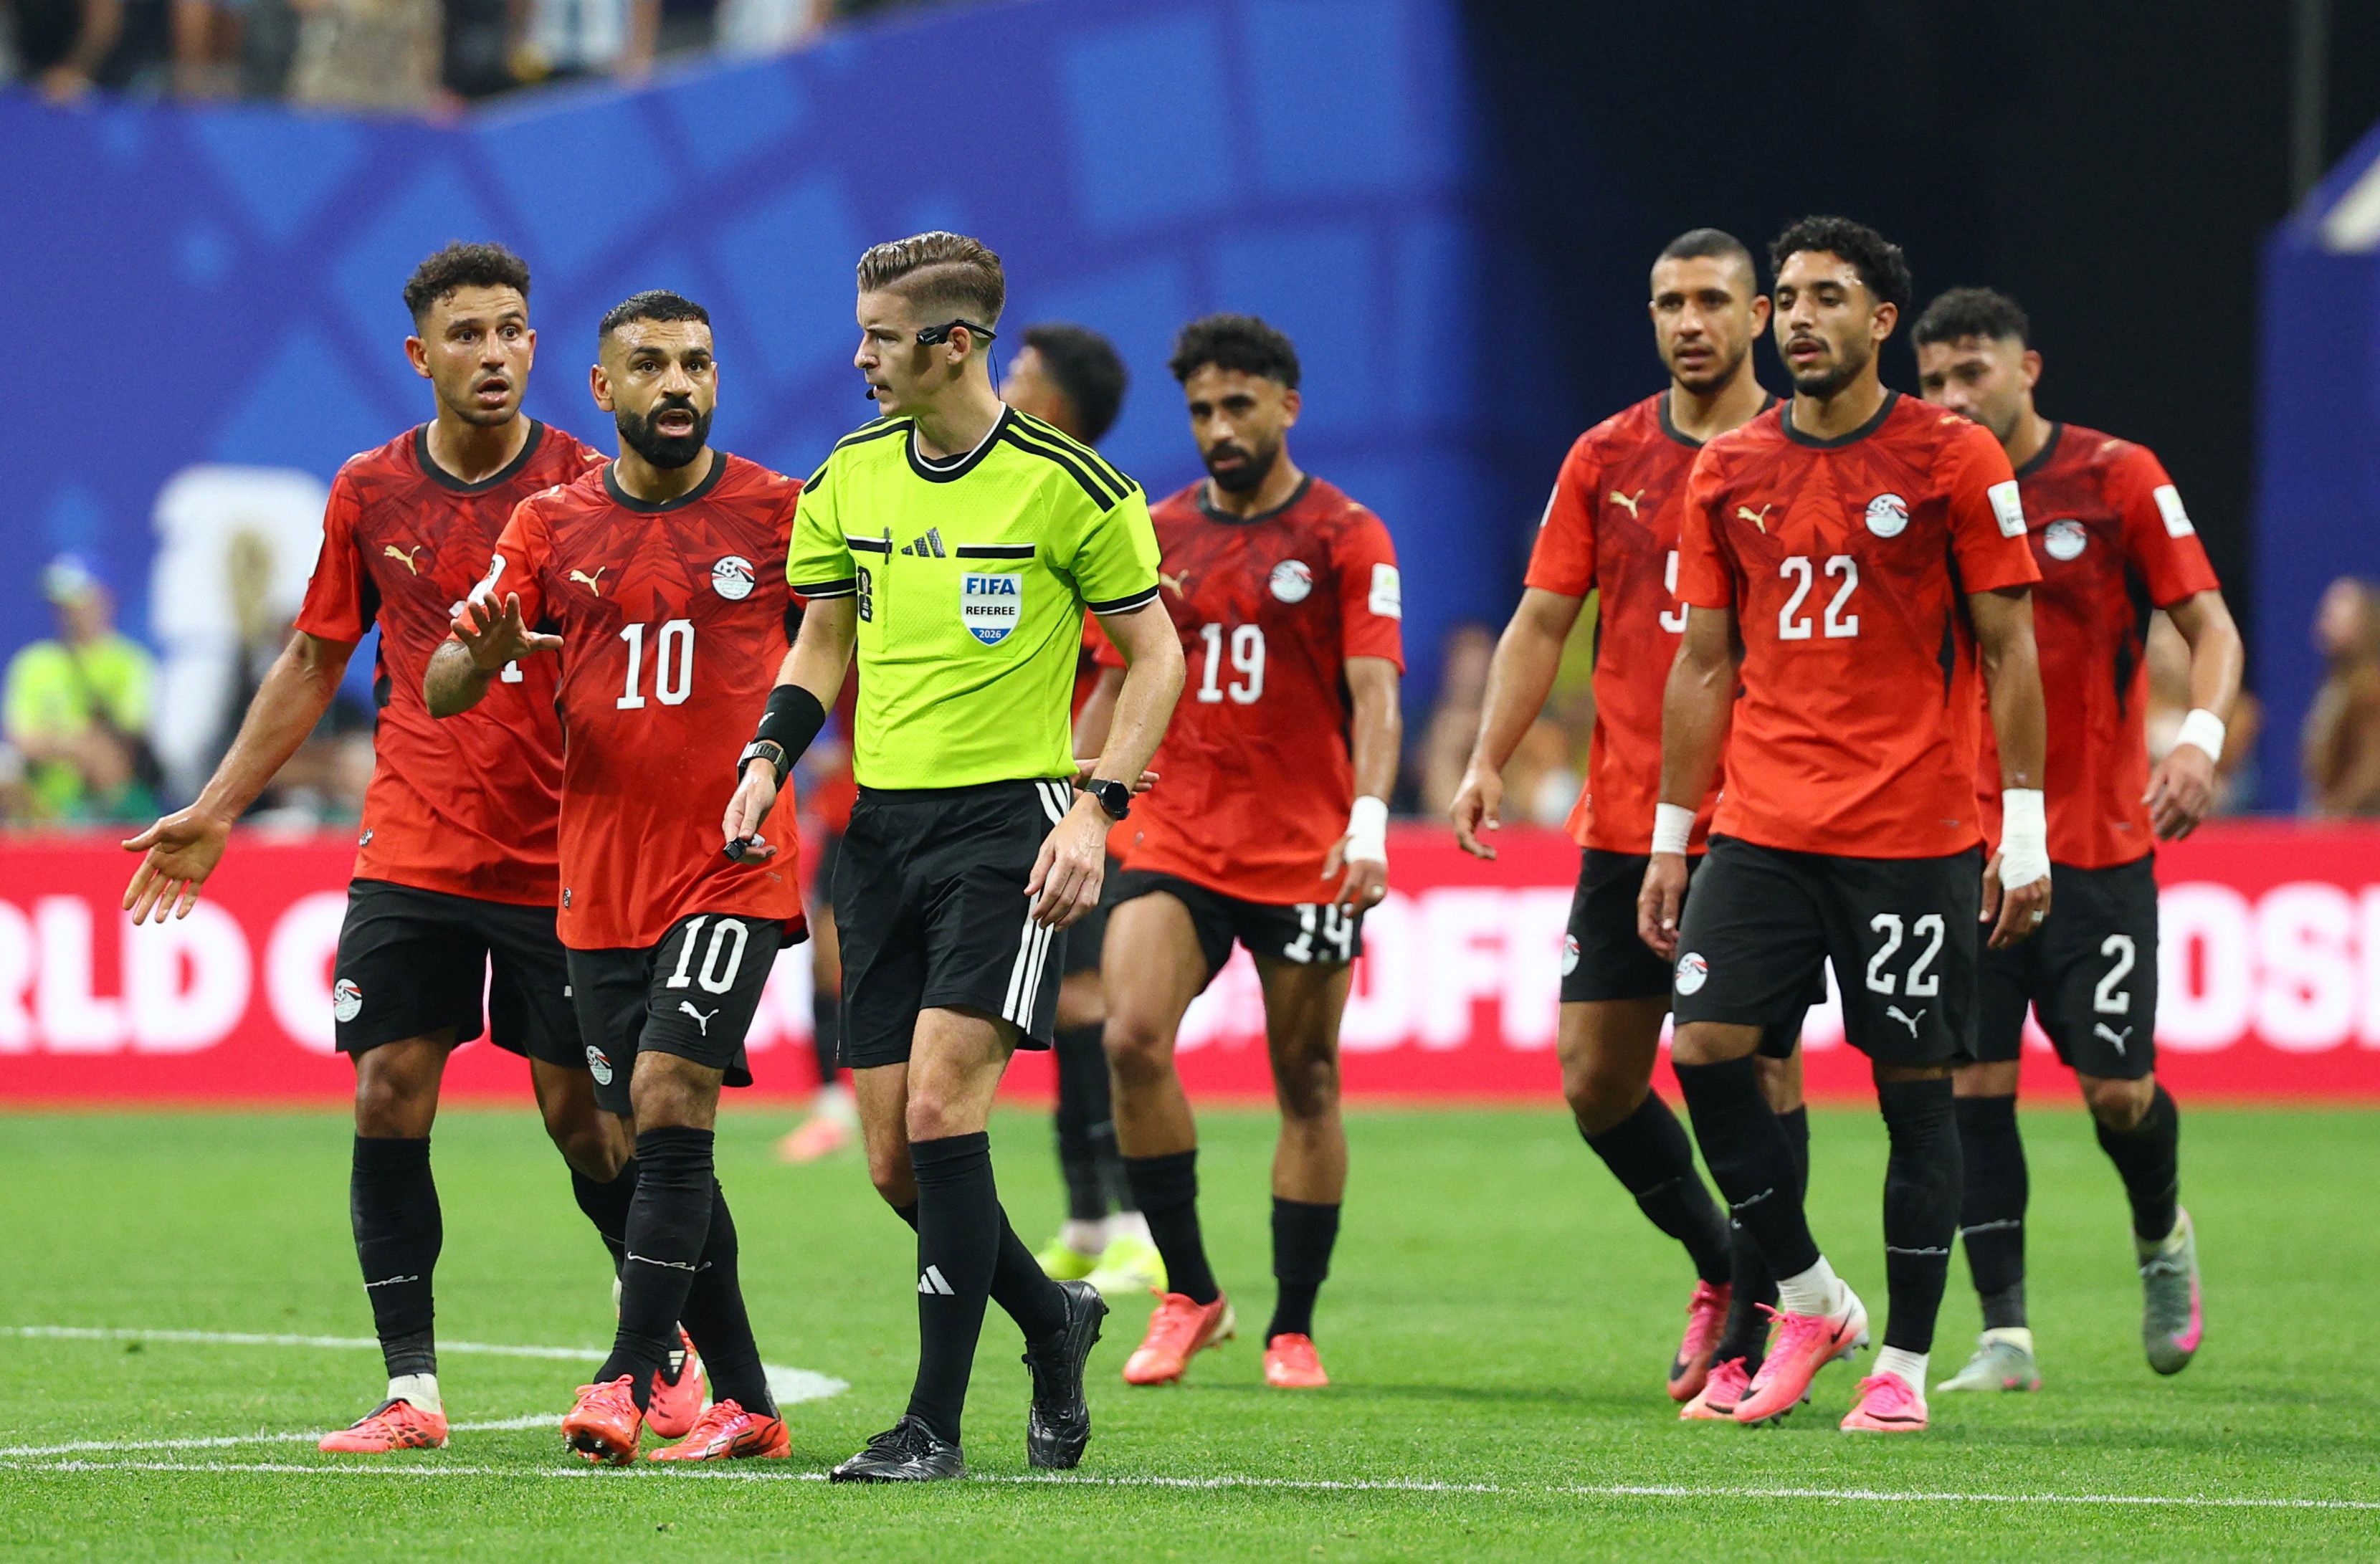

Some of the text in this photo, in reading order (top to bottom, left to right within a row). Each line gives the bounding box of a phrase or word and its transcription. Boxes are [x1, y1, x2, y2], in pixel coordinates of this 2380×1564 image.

[966, 606, 1016, 616] REFEREE
[967, 577, 1016, 595] FIFA
[1779, 554, 1858, 640] 22
[616, 619, 695, 710] 10
[979, 629, 1001, 639] 2026
[1196, 622, 1266, 704] 19
[666, 915, 748, 994] 10
[1866, 912, 1945, 996] 22
[2093, 934, 2136, 1014] 2
